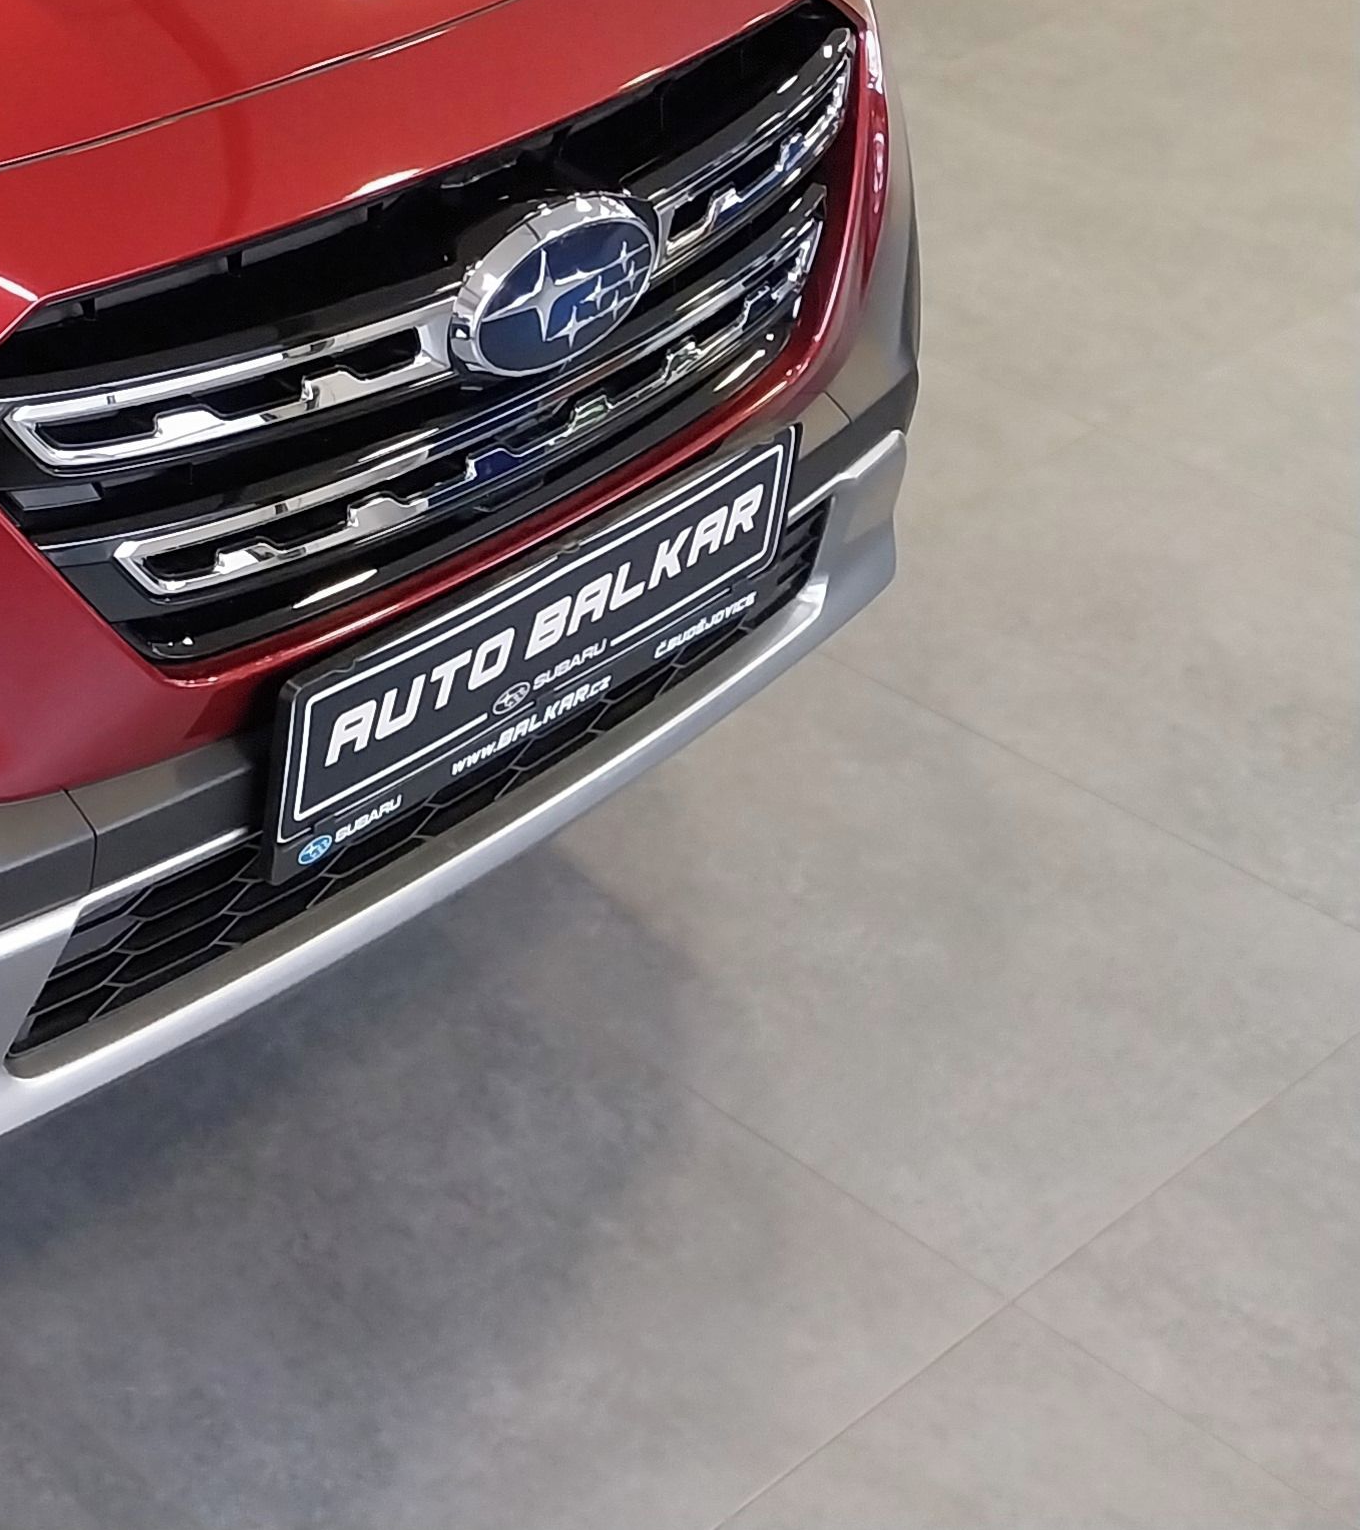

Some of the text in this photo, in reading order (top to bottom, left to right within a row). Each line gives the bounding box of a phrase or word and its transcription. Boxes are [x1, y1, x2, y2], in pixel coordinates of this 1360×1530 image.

[323, 483, 765, 767] AUTO BALKAR
[533, 637, 608, 691] SUBARU
[334, 793, 403, 843] SUBARU
